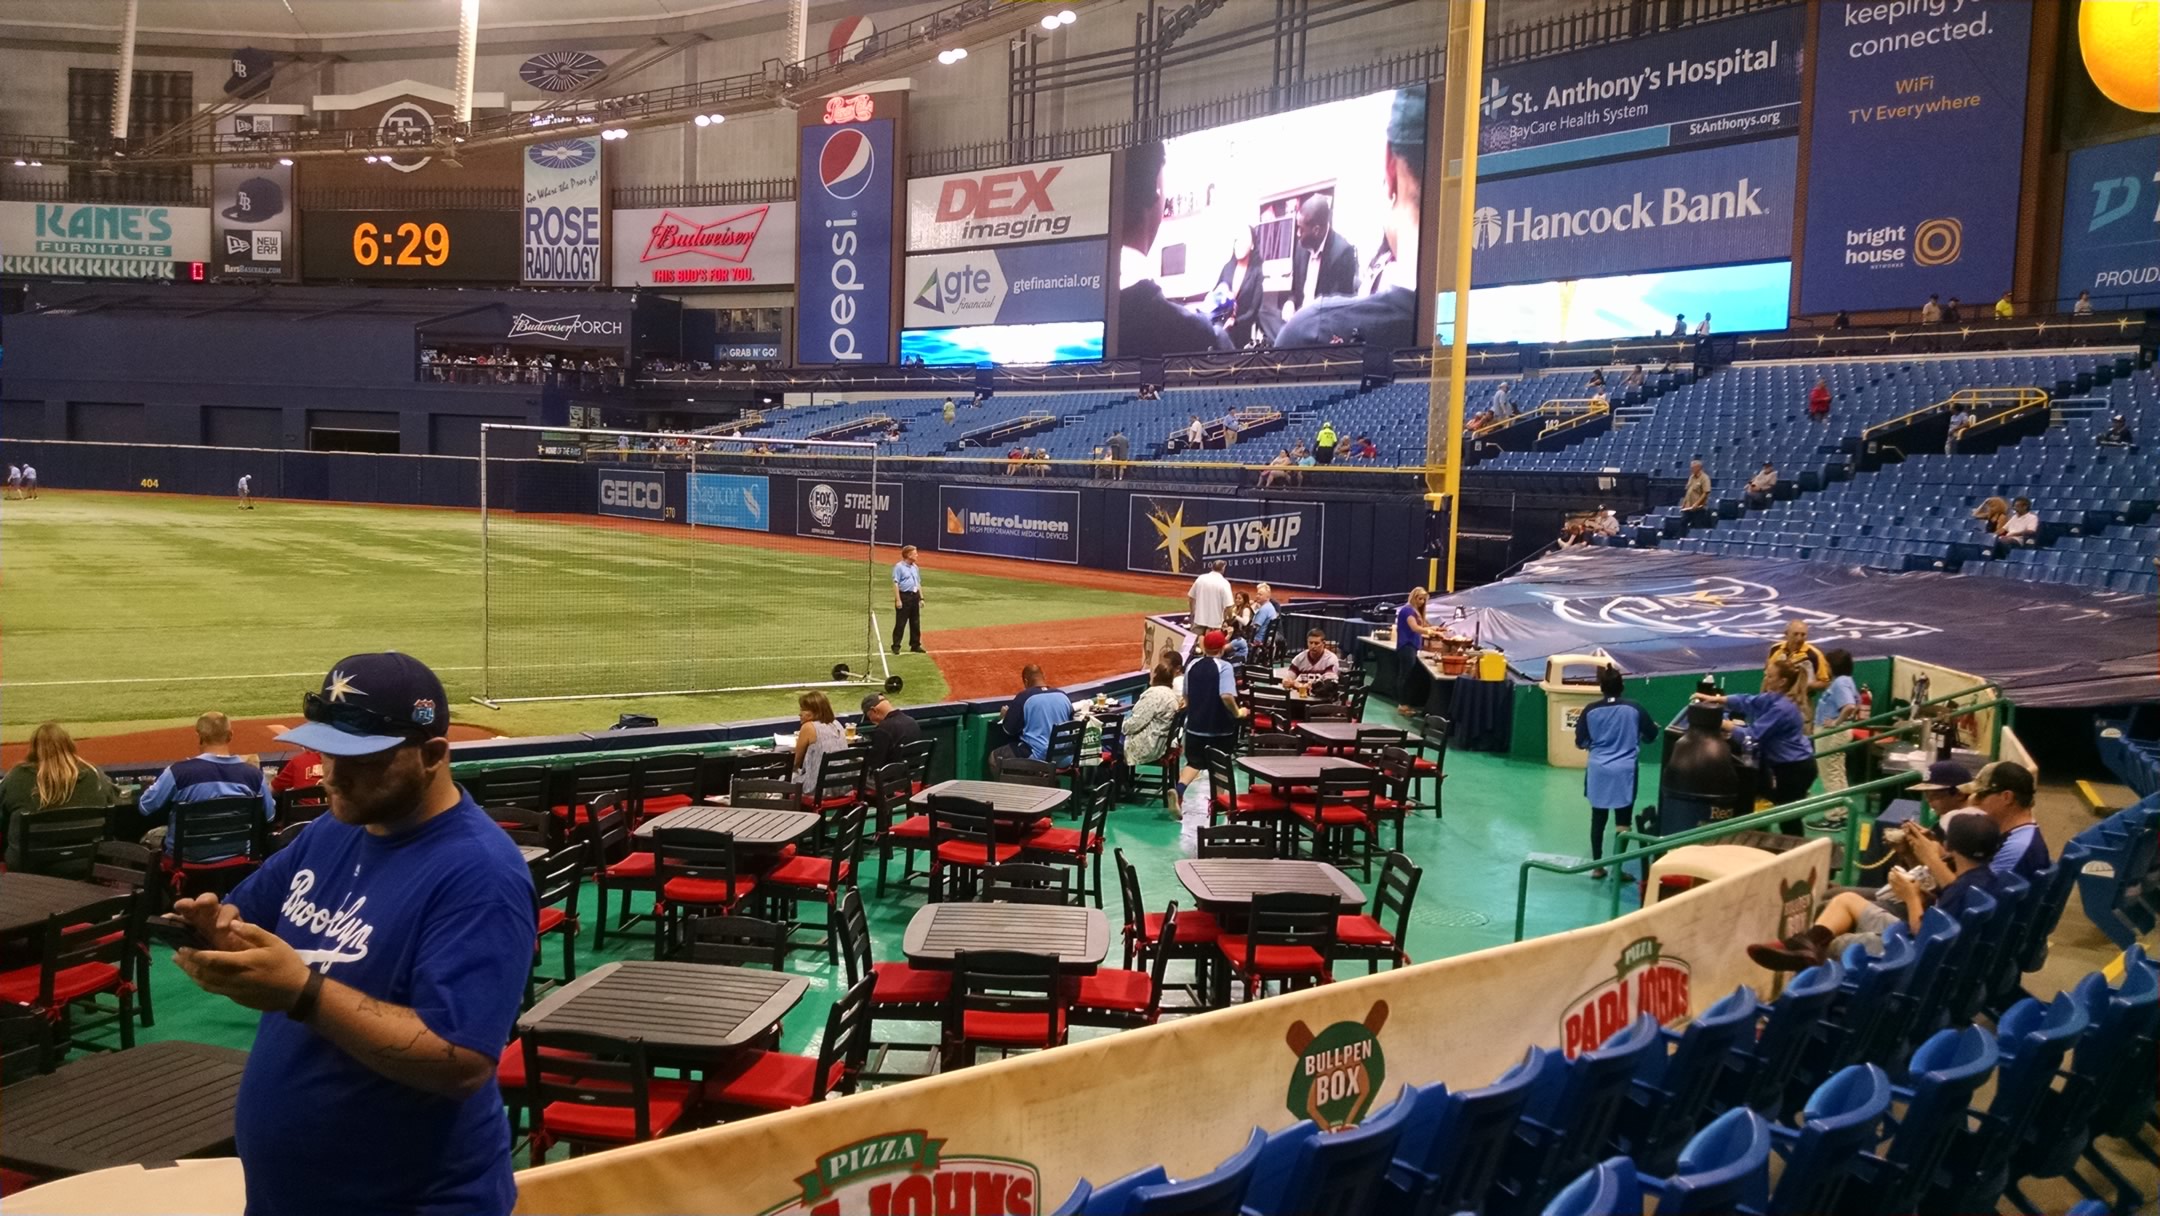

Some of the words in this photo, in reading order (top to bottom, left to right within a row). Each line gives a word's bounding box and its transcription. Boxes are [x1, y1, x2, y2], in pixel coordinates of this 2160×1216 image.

[1849, 11, 1993, 58] connected.
[1511, 92, 1539, 116] St.
[1543, 67, 1661, 110] Anthony's
[1667, 39, 1778, 85] Hospital
[1895, 75, 1934, 94] WiFi
[1509, 120, 1557, 140] BayCare
[1559, 110, 1600, 130] Health
[1603, 102, 1649, 122] System
[1848, 107, 1873, 124] TV
[1876, 94, 1981, 120] Everywhere
[1689, 111, 1781, 136] StAnthonys.org
[935, 166, 1064, 223] DEX
[36, 204, 172, 241] KANE'S
[1504, 191, 1656, 244] Hancock
[1661, 177, 1763, 227] Bank
[525, 206, 599, 246] ROSE
[651, 225, 755, 249] Budweiser
[962, 214, 1072, 239] imaging
[1846, 225, 1906, 247] bright
[41, 242, 165, 256] FURNITURE
[257, 237, 278, 246] NEW
[257, 246, 278, 255] ERA
[353, 222, 450, 267] 6:29
[525, 246, 599, 280] RADIOLOGY
[1845, 247, 1906, 265] house
[652, 269, 676, 282] THIS
[677, 268, 708, 282] BUD'S
[709, 268, 729, 282] FOR
[944, 264, 991, 304] gte
[1013, 273, 1100, 294] gtefinancial.org
[2094, 266, 2160, 288] PROUD
[825, 217, 864, 360] pepsi
[952, 295, 996, 314] financial
[514, 319, 574, 332] Budweiser
[573, 320, 622, 334] PORCH
[729, 348, 752, 358] GRAB
[140, 478, 159, 488] 404
[601, 479, 663, 510] GEICO
[815, 491, 832, 507] FOX
[665, 506, 676, 518] 370
[969, 512, 1069, 532] MicroLumen
[983, 527, 1020, 537] PERFORMANCE
[1021, 531, 1045, 539] MEDICAL
[1046, 532, 1069, 540] DEVICES
[1202, 520, 1263, 555] RAYS
[1267, 516, 1301, 549] UP
[1242, 553, 1298, 566] COMMUNITY
[281, 869, 374, 970] Brooklyn
[1305, 1039, 1372, 1076] BULLPEN
[1316, 1065, 1361, 1107] BOX
[829, 1136, 915, 1179] PIZZA
